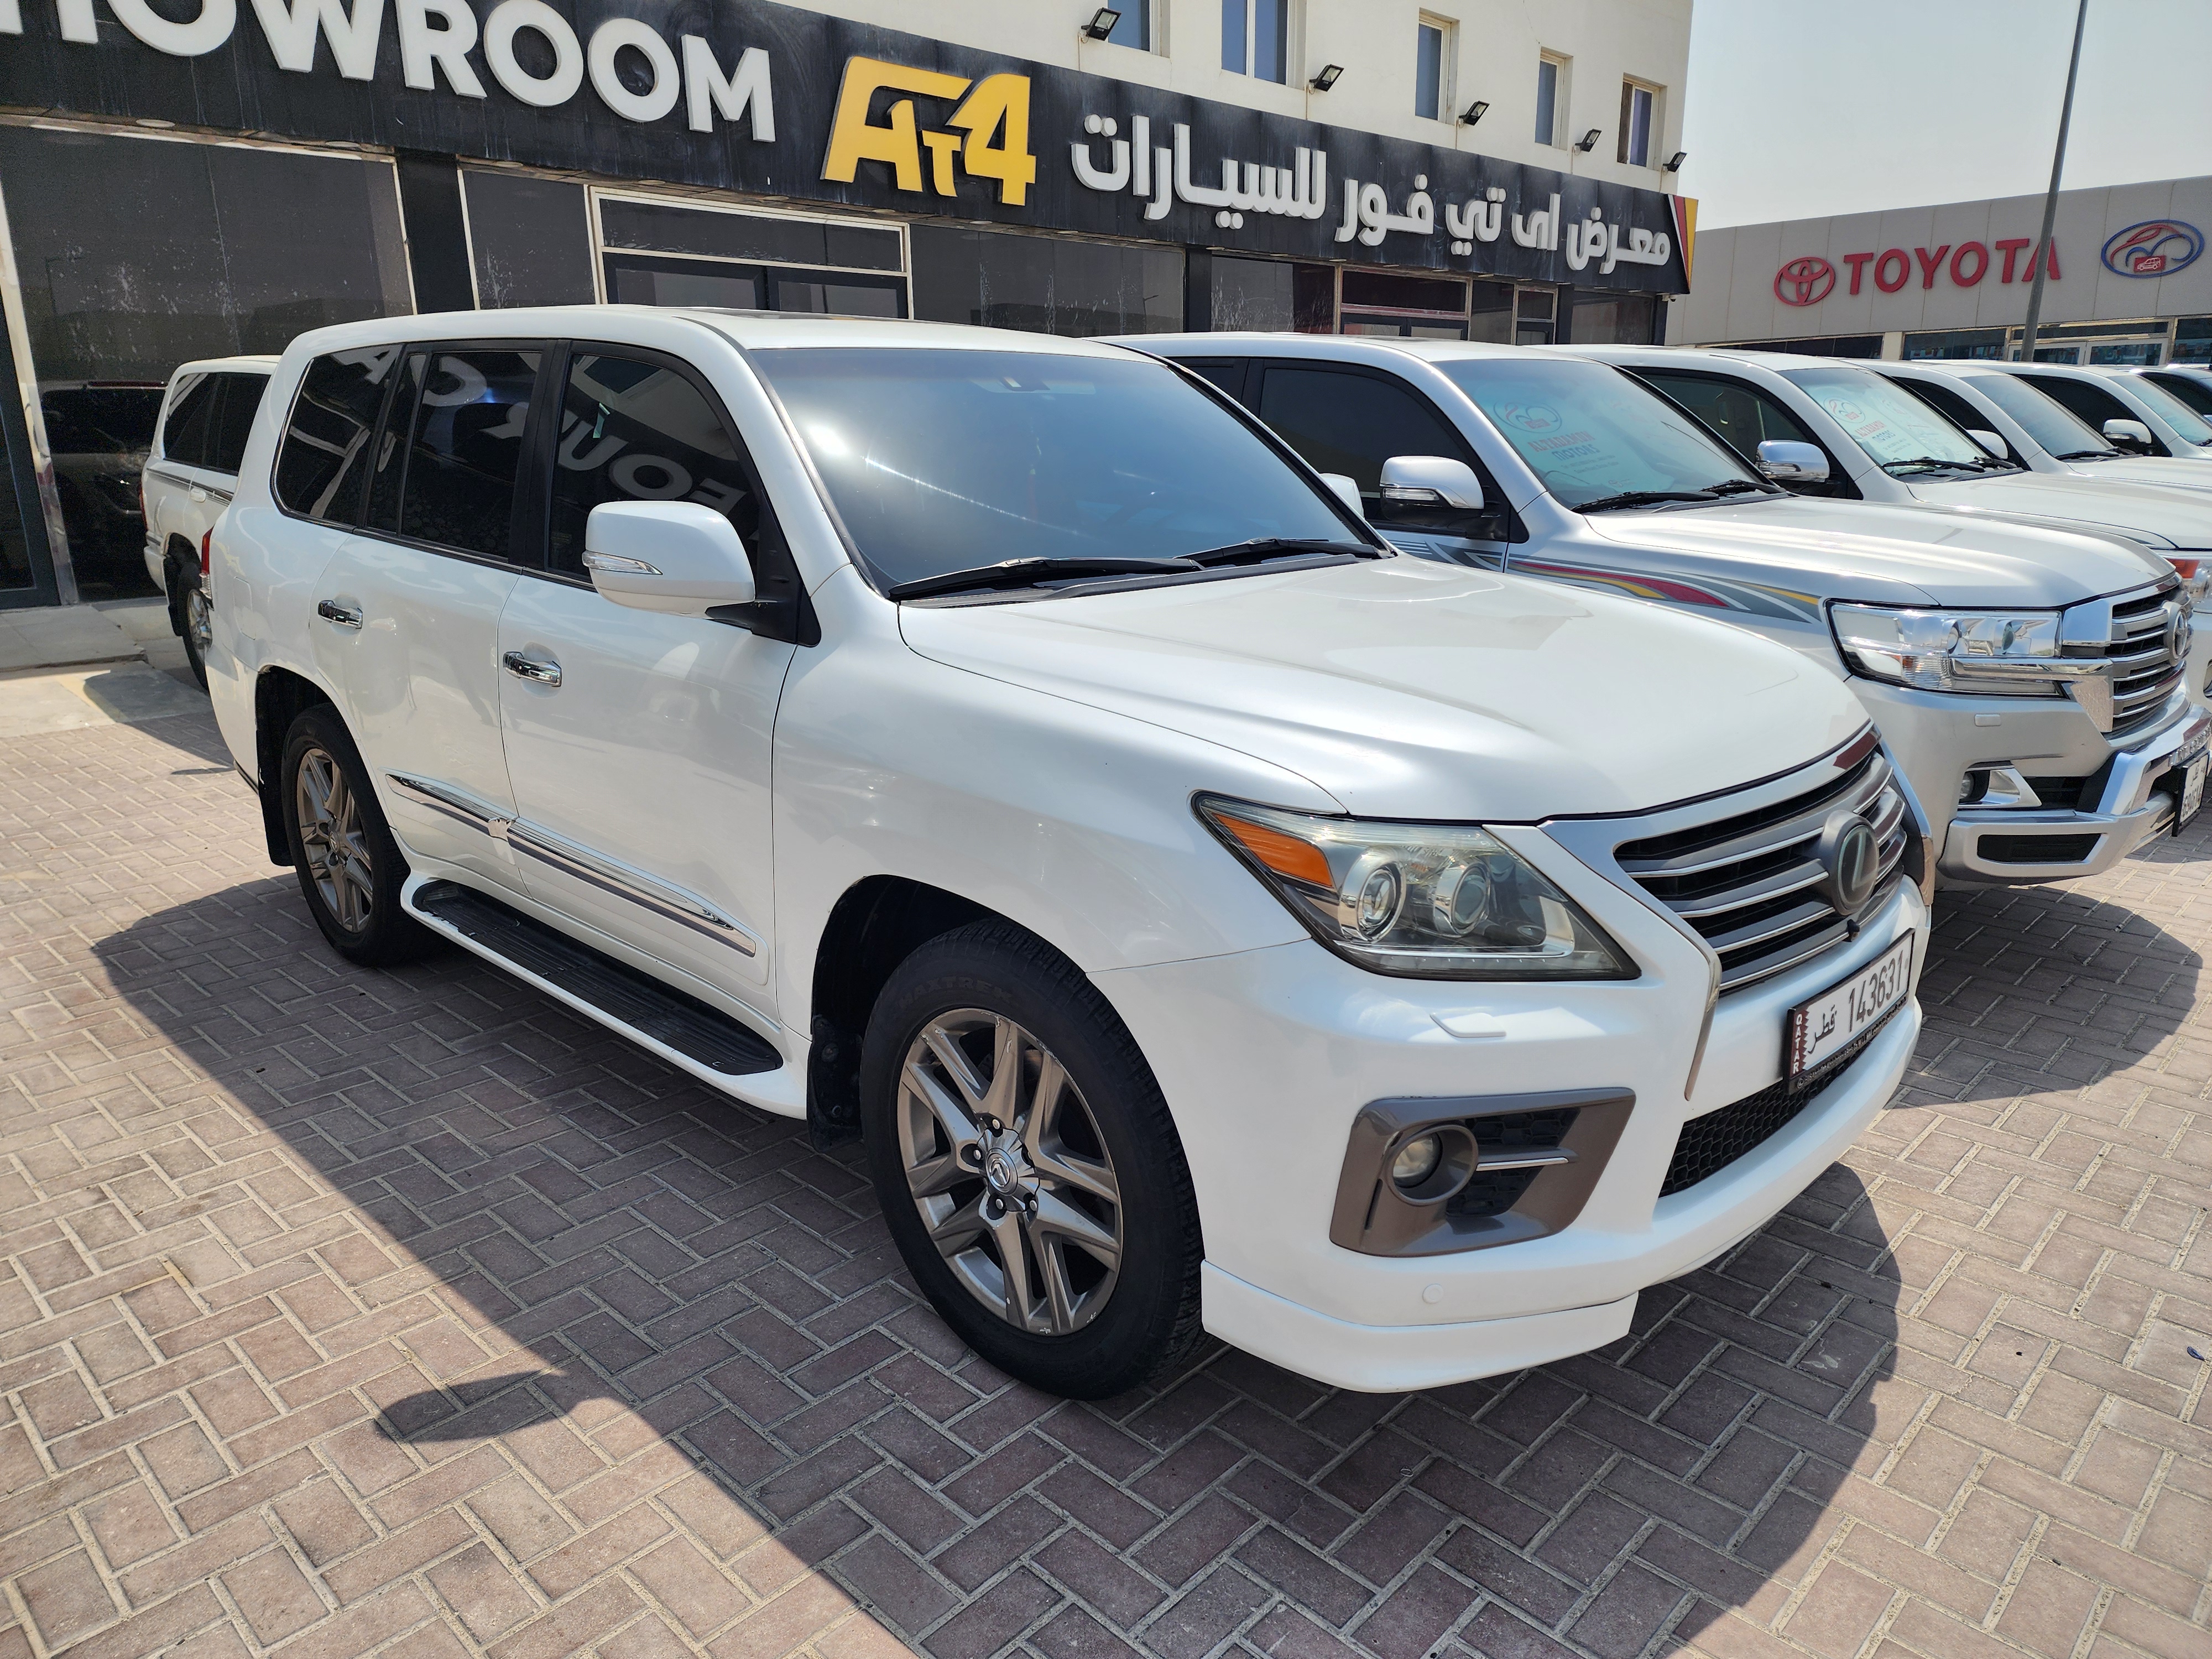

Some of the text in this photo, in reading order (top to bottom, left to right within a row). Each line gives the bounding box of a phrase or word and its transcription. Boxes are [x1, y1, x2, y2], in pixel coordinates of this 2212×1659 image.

[1071, 113, 1327, 230] للسيارات
[1334, 174, 1434, 247] فور
[1566, 207, 1671, 275] معرض
[1843, 236, 2061, 295] TOYOTA
[1551, 443, 1601, 461] MOTORS
[1848, 950, 1904, 1033] 143631
[1793, 1014, 1803, 1074] QATAR
[1807, 1004, 1838, 1055] قطر
